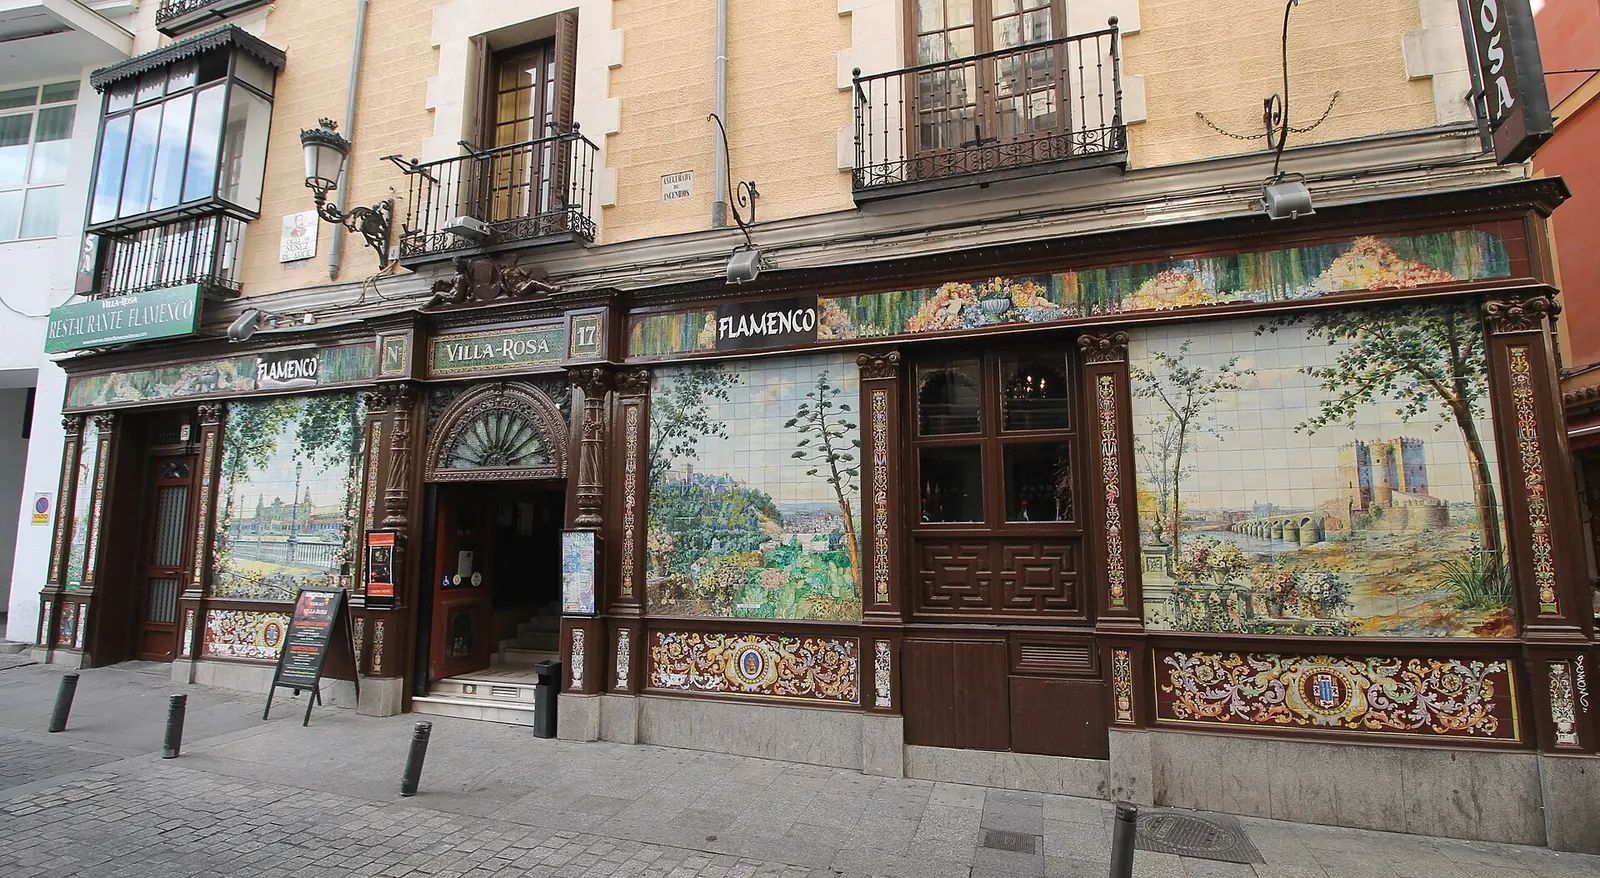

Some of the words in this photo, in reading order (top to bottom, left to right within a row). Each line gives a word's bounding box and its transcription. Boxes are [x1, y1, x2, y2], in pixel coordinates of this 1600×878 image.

[101, 296, 138, 309] VILLA-ROSA
[48, 310, 123, 339] RESTAURANTE
[128, 299, 193, 328] FLAMENCO
[718, 308, 816, 340] FLAMENCO
[576, 325, 597, 347] 17
[446, 338, 551, 362] VILLA-ROSA
[257, 357, 318, 381] FLAMENCO
